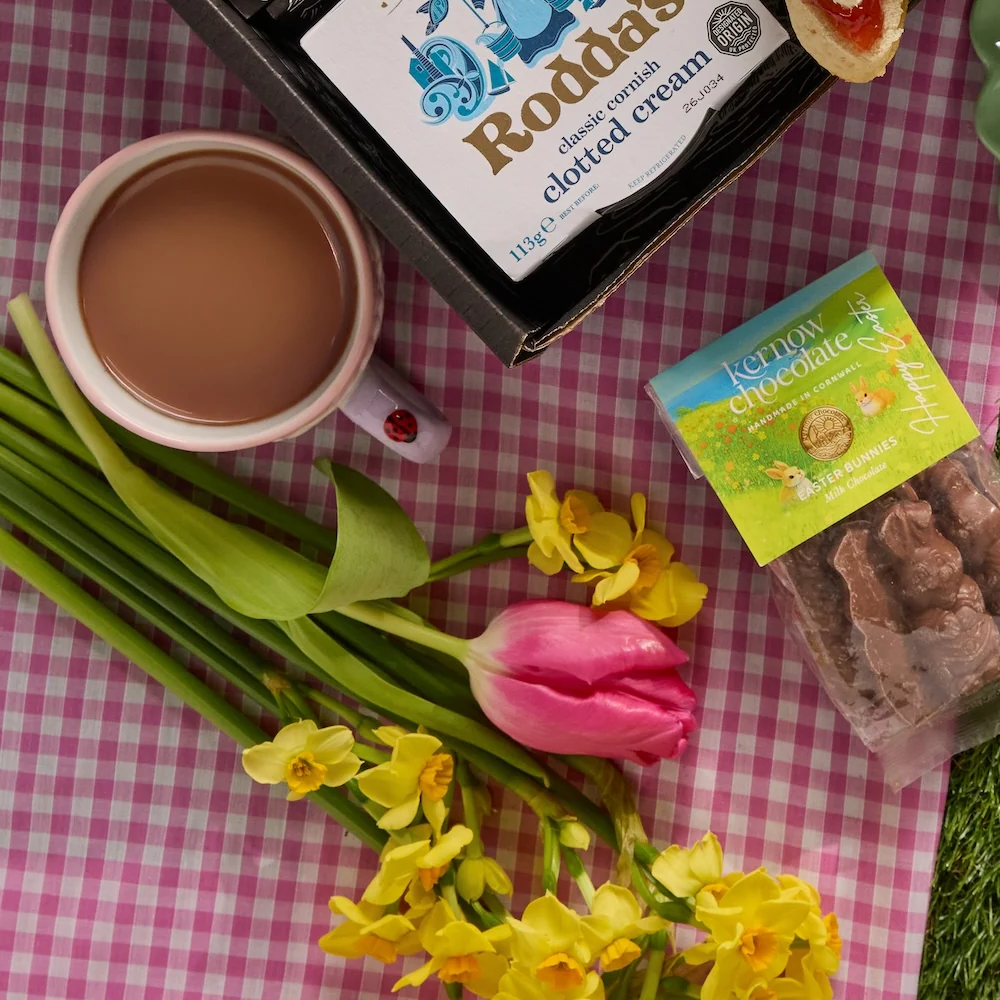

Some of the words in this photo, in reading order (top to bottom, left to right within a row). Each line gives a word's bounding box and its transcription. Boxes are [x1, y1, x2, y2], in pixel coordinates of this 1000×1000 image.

[712, 7, 743, 37] DESIGNATED
[717, 12, 753, 47] ORIGIN
[543, 116, 632, 204] clotted
[631, 50, 713, 124] cream
[557, 107, 606, 155] classic
[606, 58, 661, 112] cornish
[627, 174, 646, 190] KEEP
[644, 134, 687, 179] REFRIGERATED
[559, 204, 576, 220] BEST
[721, 313, 823, 386] kernow
[729, 332, 853, 415] chocolate
[747, 399, 799, 433] HANDMADE
[800, 391, 811, 402] IN
[812, 360, 863, 394] CORNWALL
[796, 473, 844, 502] EASTER
[843, 436, 898, 474] BUNNIES
[824, 487, 846, 504] Milk
[845, 462, 888, 490] Chocolate
